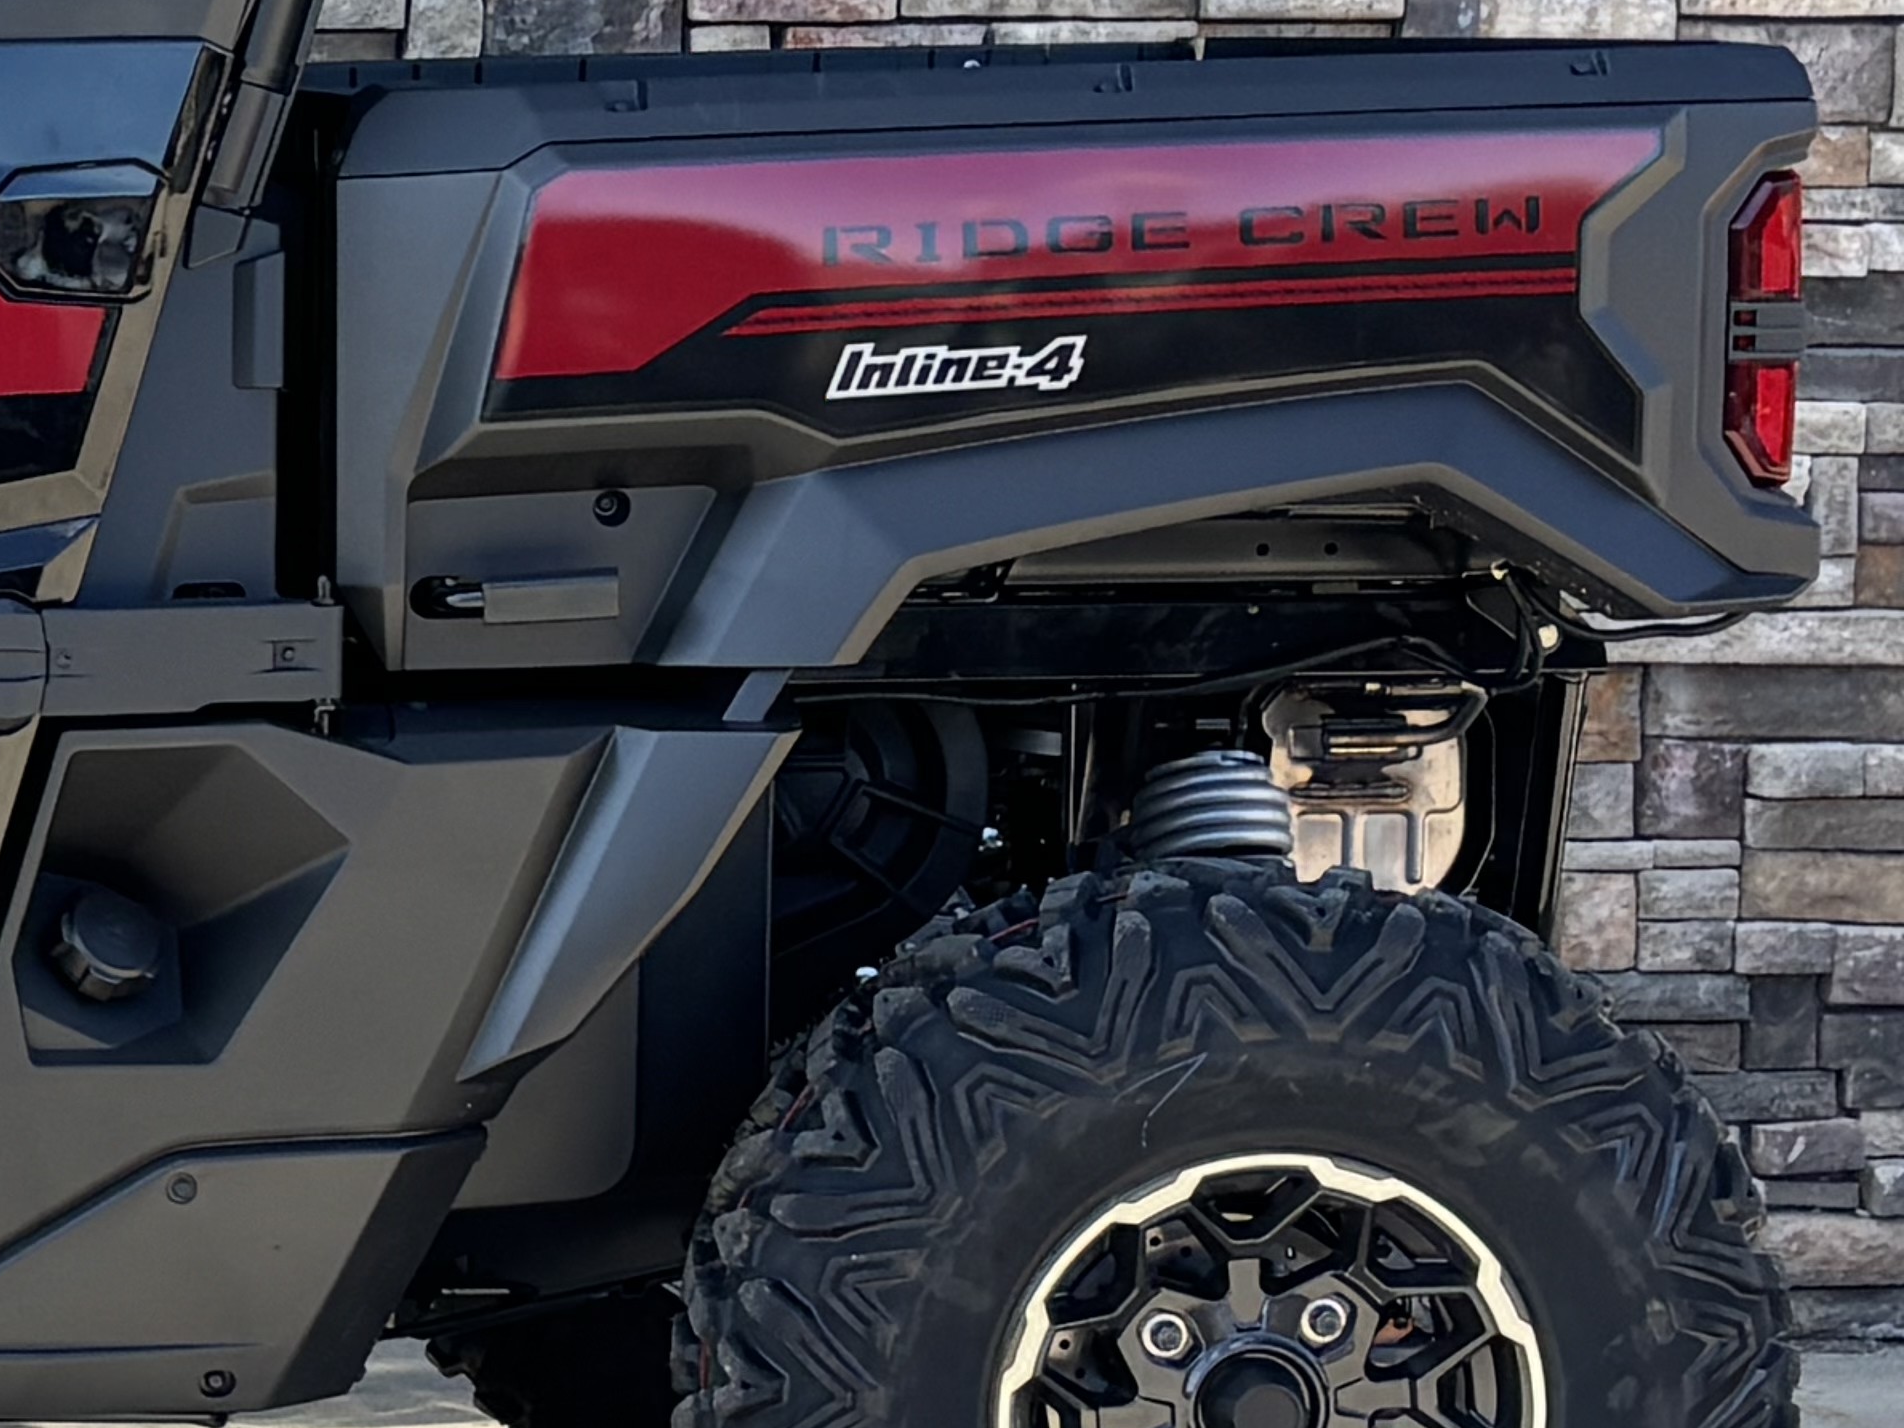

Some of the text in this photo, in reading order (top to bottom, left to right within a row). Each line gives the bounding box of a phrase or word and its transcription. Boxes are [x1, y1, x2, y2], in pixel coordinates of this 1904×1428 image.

[823, 196, 1540, 266] RIDGE CREW
[827, 336, 1087, 399] Inline-4
